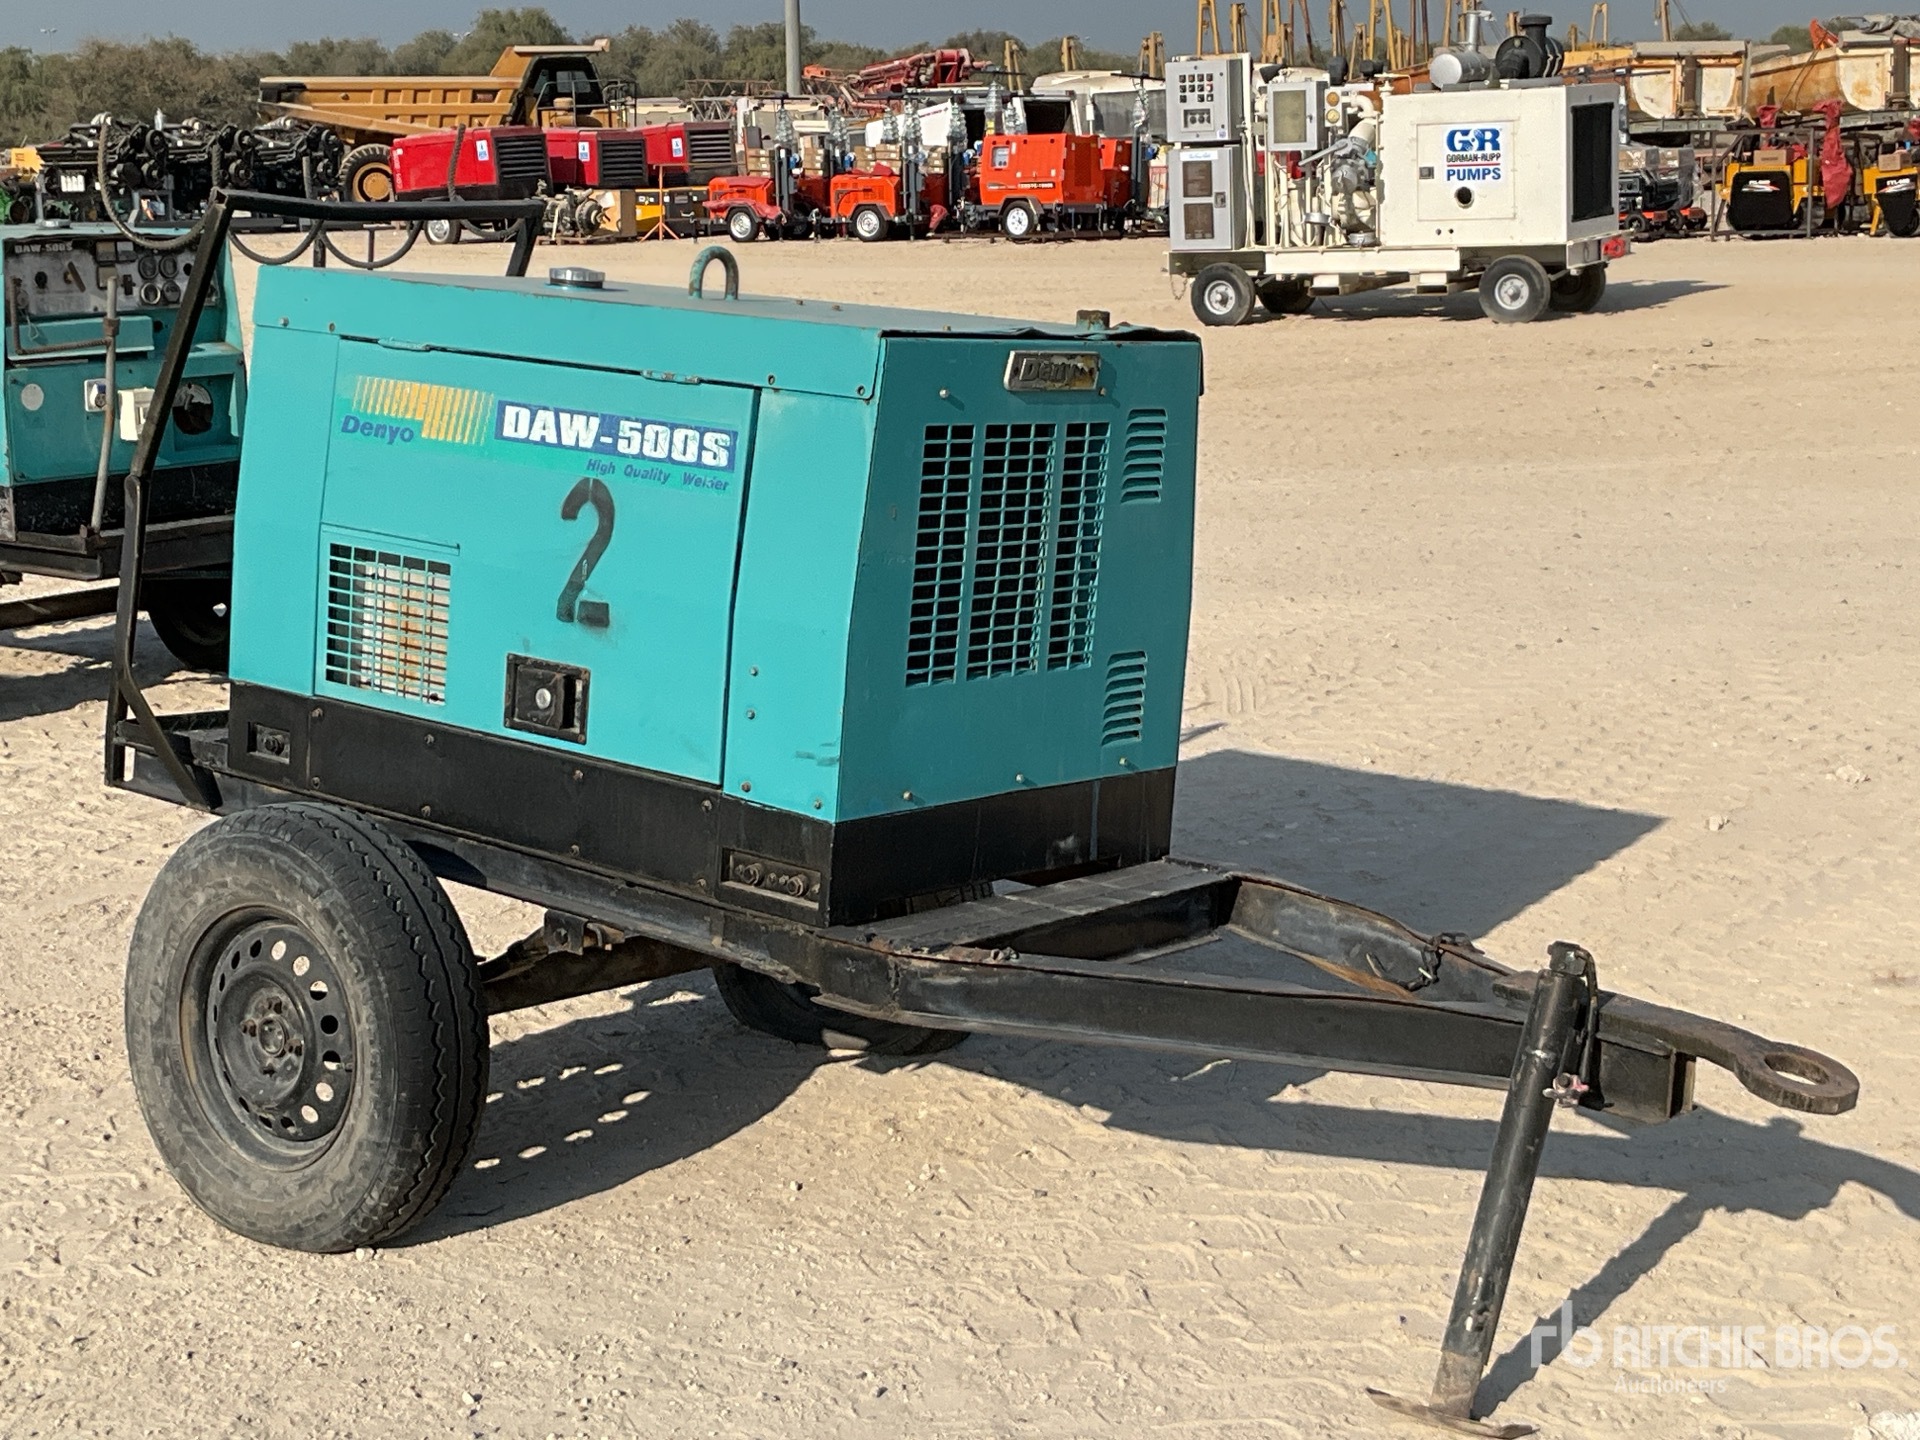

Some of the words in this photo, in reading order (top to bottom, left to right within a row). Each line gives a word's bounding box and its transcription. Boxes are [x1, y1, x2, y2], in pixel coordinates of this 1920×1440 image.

[1446, 152, 1501, 163] GORMAN-RUPP
[1446, 167, 1502, 181] PUMPS
[341, 414, 415, 446] Denyo
[502, 404, 730, 468] DAW-500S
[586, 458, 616, 477] High
[623, 464, 671, 485] Quality
[556, 477, 615, 627] 2
